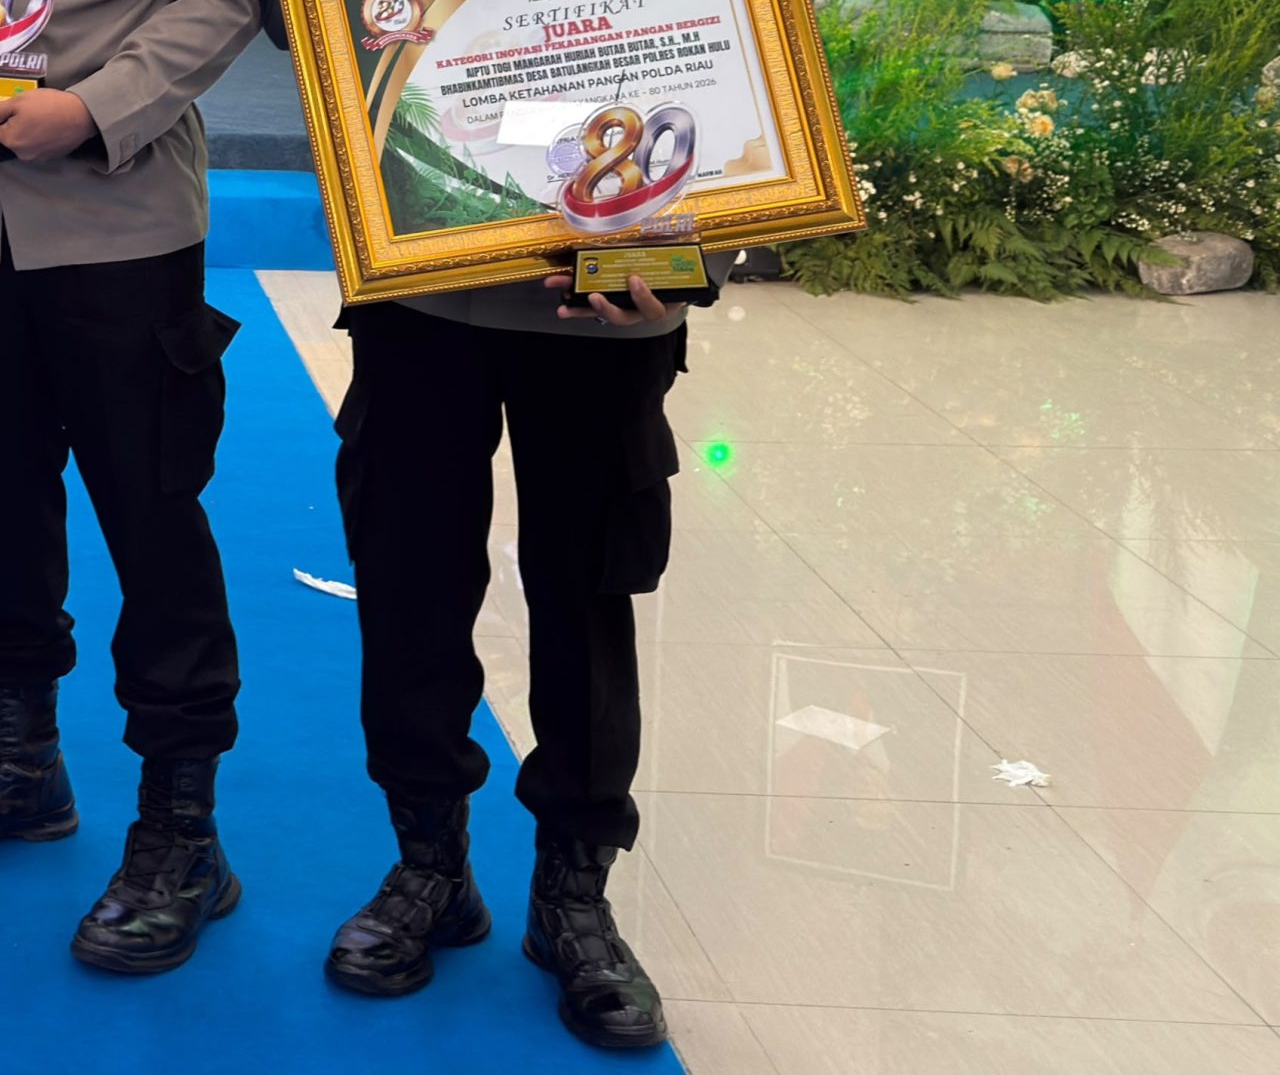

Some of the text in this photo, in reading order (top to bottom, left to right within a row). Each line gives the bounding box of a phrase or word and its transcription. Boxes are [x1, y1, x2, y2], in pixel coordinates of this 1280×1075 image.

[435, 15, 721, 69] KATEGORI INOVASI PEKARANGAN PANGAN BERGIZI
[543, 15, 613, 43] JUARA
[440, 72, 525, 96] BHABINKAMTIBMAS
[526, 69, 549, 82] DESA
[613, 54, 641, 69] BESAR
[643, 49, 676, 64] POLRES
[677, 44, 706, 58] ROKAN
[708, 39, 731, 52] HULU
[465, 66, 491, 78] AIPTU
[493, 61, 512, 74] TOGI
[513, 53, 563, 71] MANGARAH
[598, 43, 626, 58] BUTAR
[627, 37, 659, 53] BUTAR,
[462, 59, 714, 108] LOMBA KETAHANAN PANGAN POLDA RIAU
[649, 86, 661, 96] 80
[662, 81, 693, 93] TAHUN
[695, 77, 717, 89] 2026
[568, 107, 695, 221] 80
